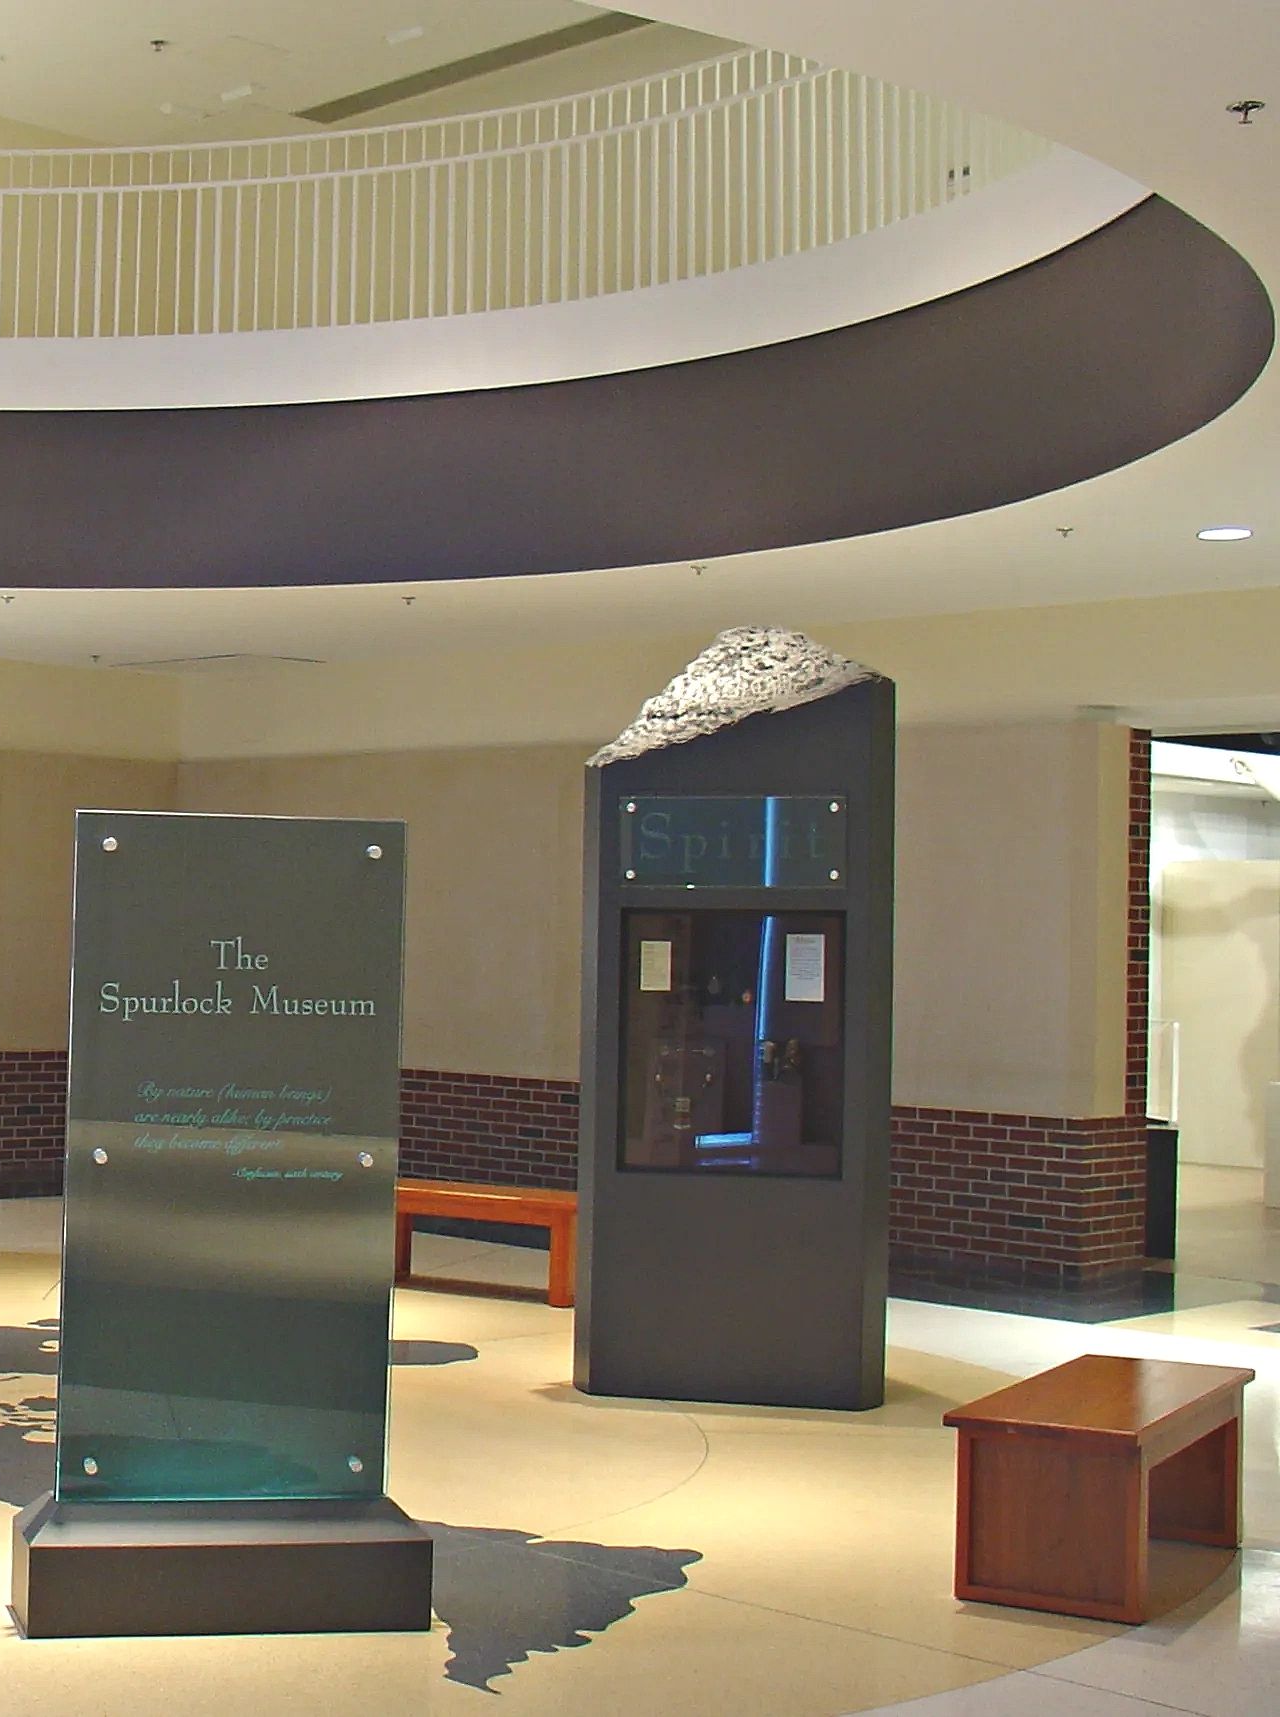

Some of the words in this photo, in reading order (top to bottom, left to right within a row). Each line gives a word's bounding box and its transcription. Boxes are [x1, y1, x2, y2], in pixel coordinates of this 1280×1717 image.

[639, 811, 826, 874] Spirit
[210, 936, 269, 971] The
[99, 979, 232, 1022] Spurlock
[249, 983, 377, 1017] Museum
